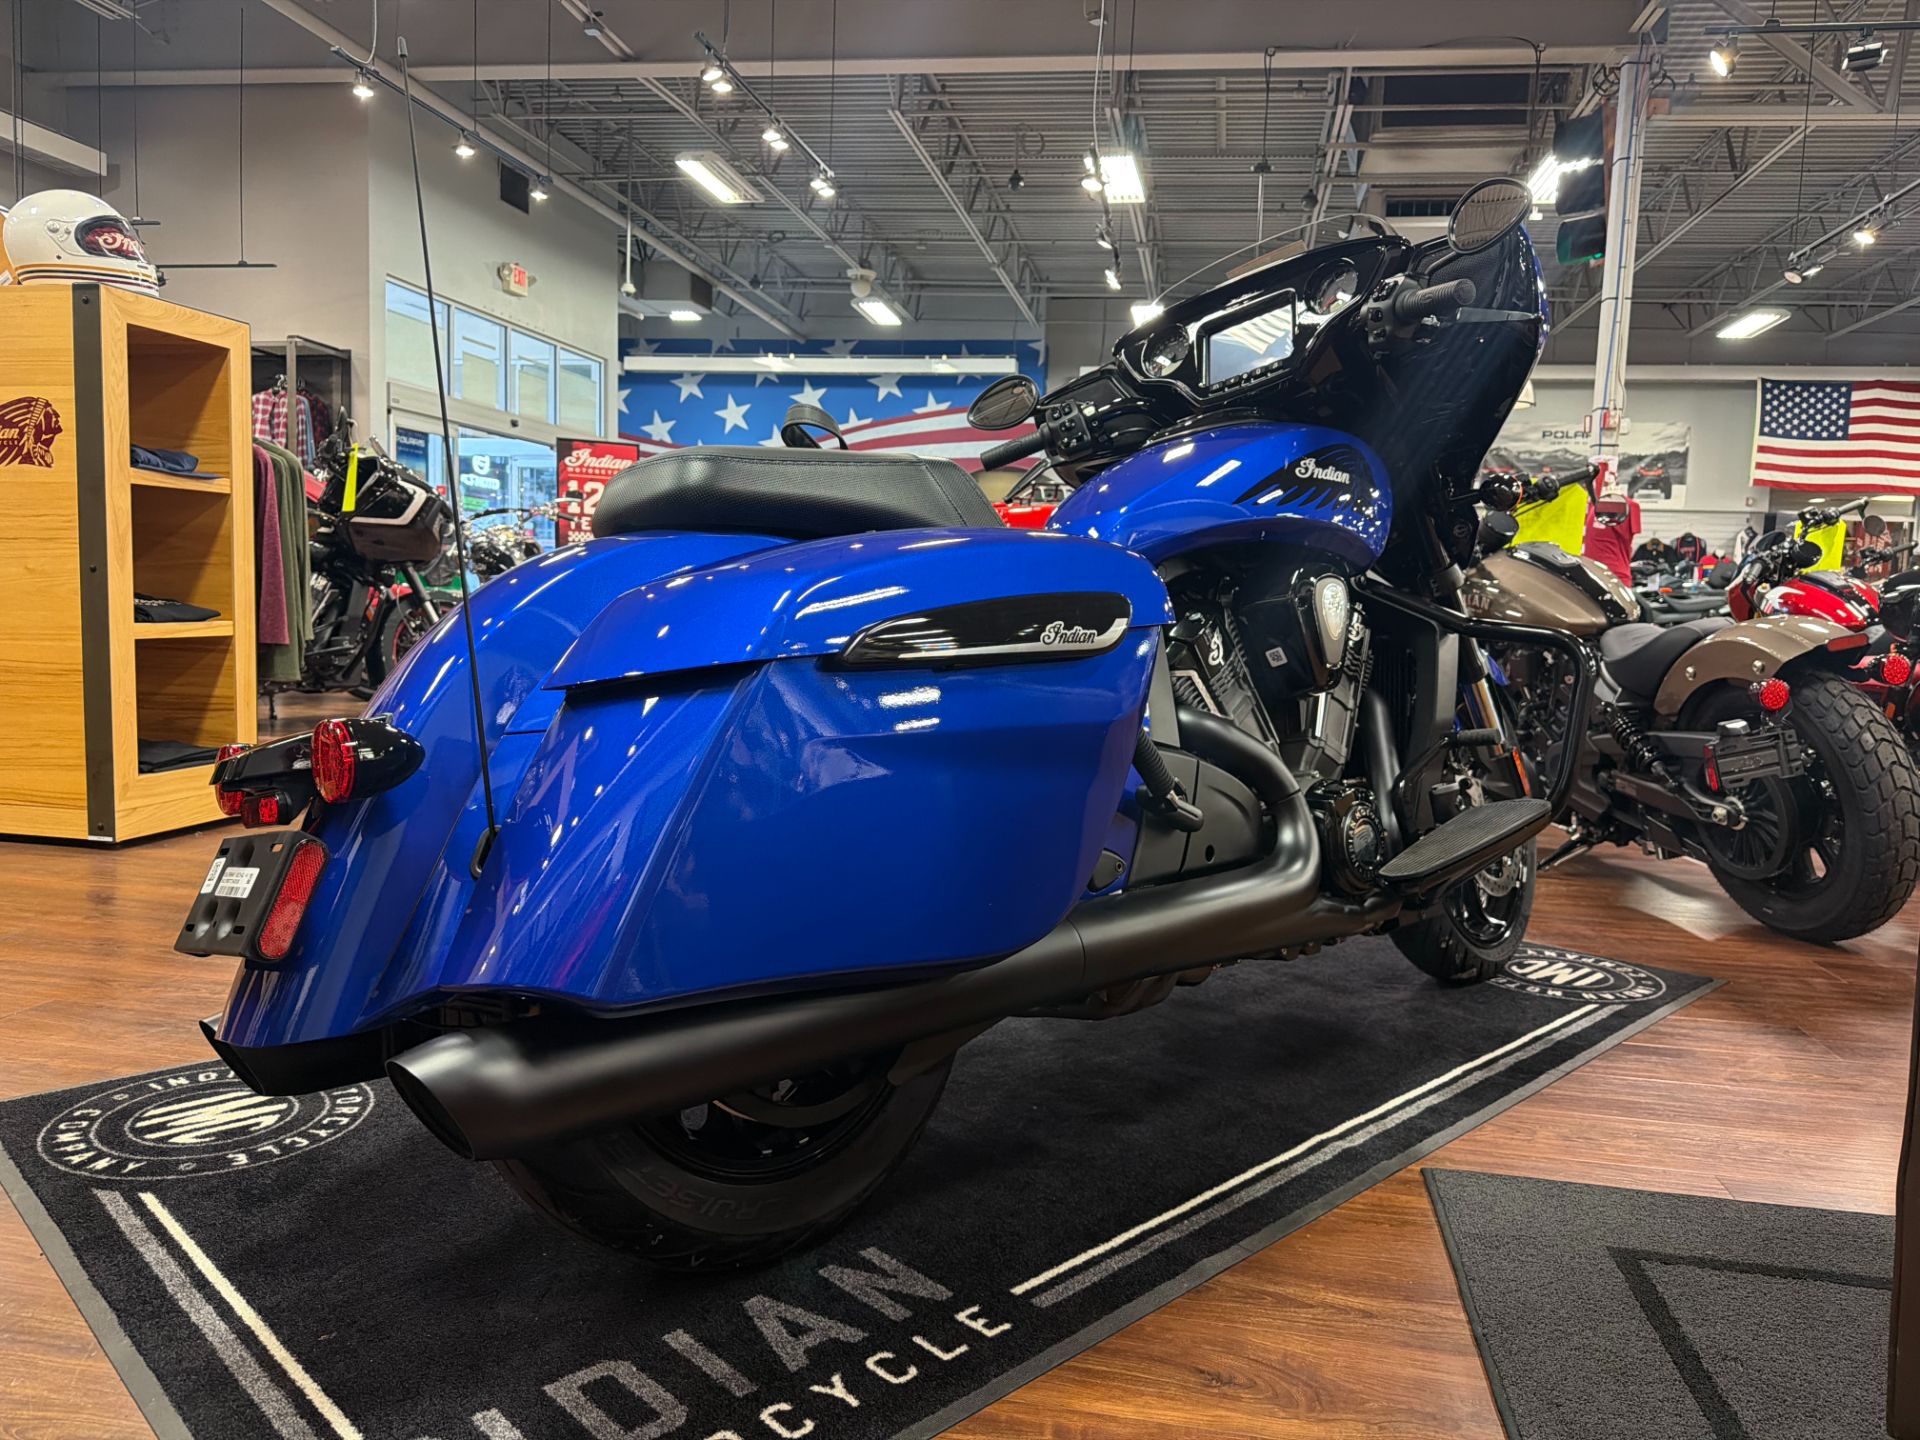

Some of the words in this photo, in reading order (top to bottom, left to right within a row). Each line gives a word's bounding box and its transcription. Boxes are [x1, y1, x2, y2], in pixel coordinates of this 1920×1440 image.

[1542, 430, 1592, 439] POLA
[564, 448, 633, 469] Indian
[567, 467, 620, 475] MOTORCYC
[1295, 457, 1351, 484] Indian
[567, 480, 606, 515] 12
[1041, 620, 1098, 645] Indian
[148, 1068, 236, 1091] INDI
[51, 1107, 147, 1174] COMPANY
[226, 1087, 364, 1167] TORCYCLE
[414, 1246, 954, 1440] DIAN
[703, 1304, 1013, 1440] CYCLE
